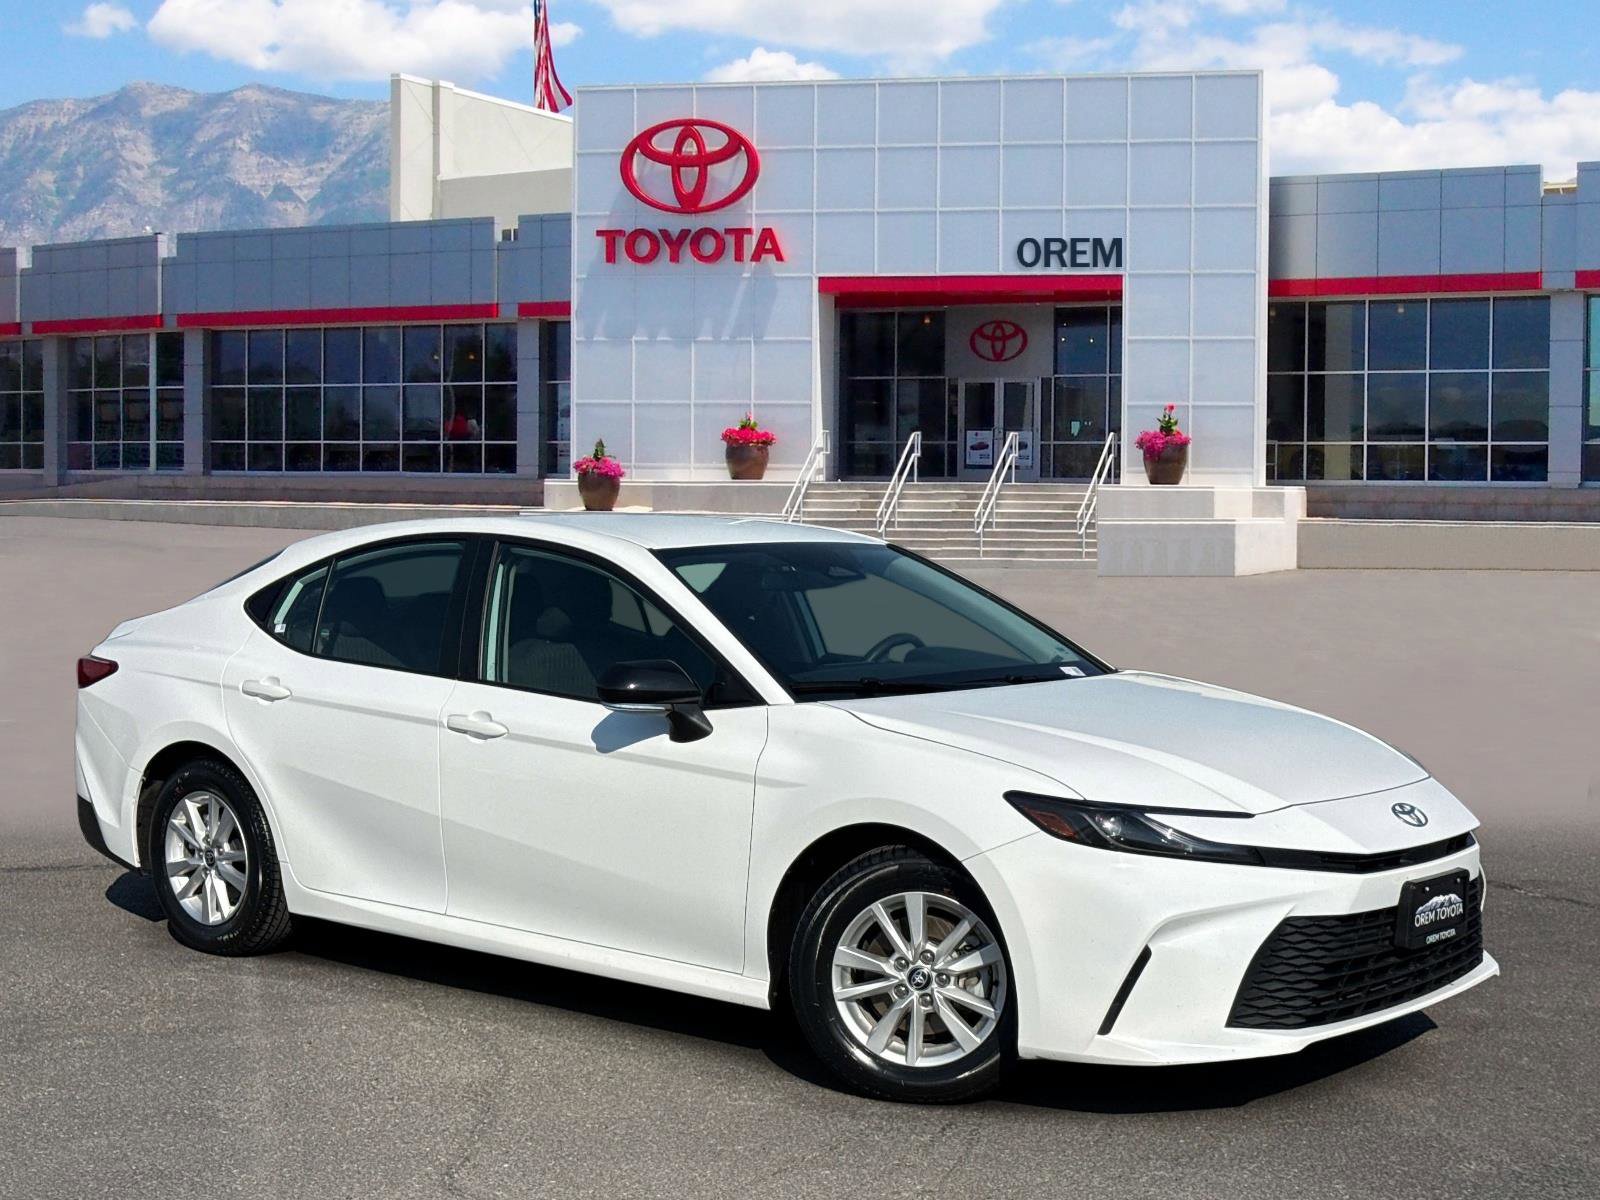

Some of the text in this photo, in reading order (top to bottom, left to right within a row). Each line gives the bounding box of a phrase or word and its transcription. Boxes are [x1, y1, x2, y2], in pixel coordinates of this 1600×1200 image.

[596, 227, 784, 264] TOYOTA
[1017, 238, 1122, 268] OREM
[1414, 903, 1463, 927] OREM TOYOTA
[1426, 928, 1456, 944] OREM TOYOTA
